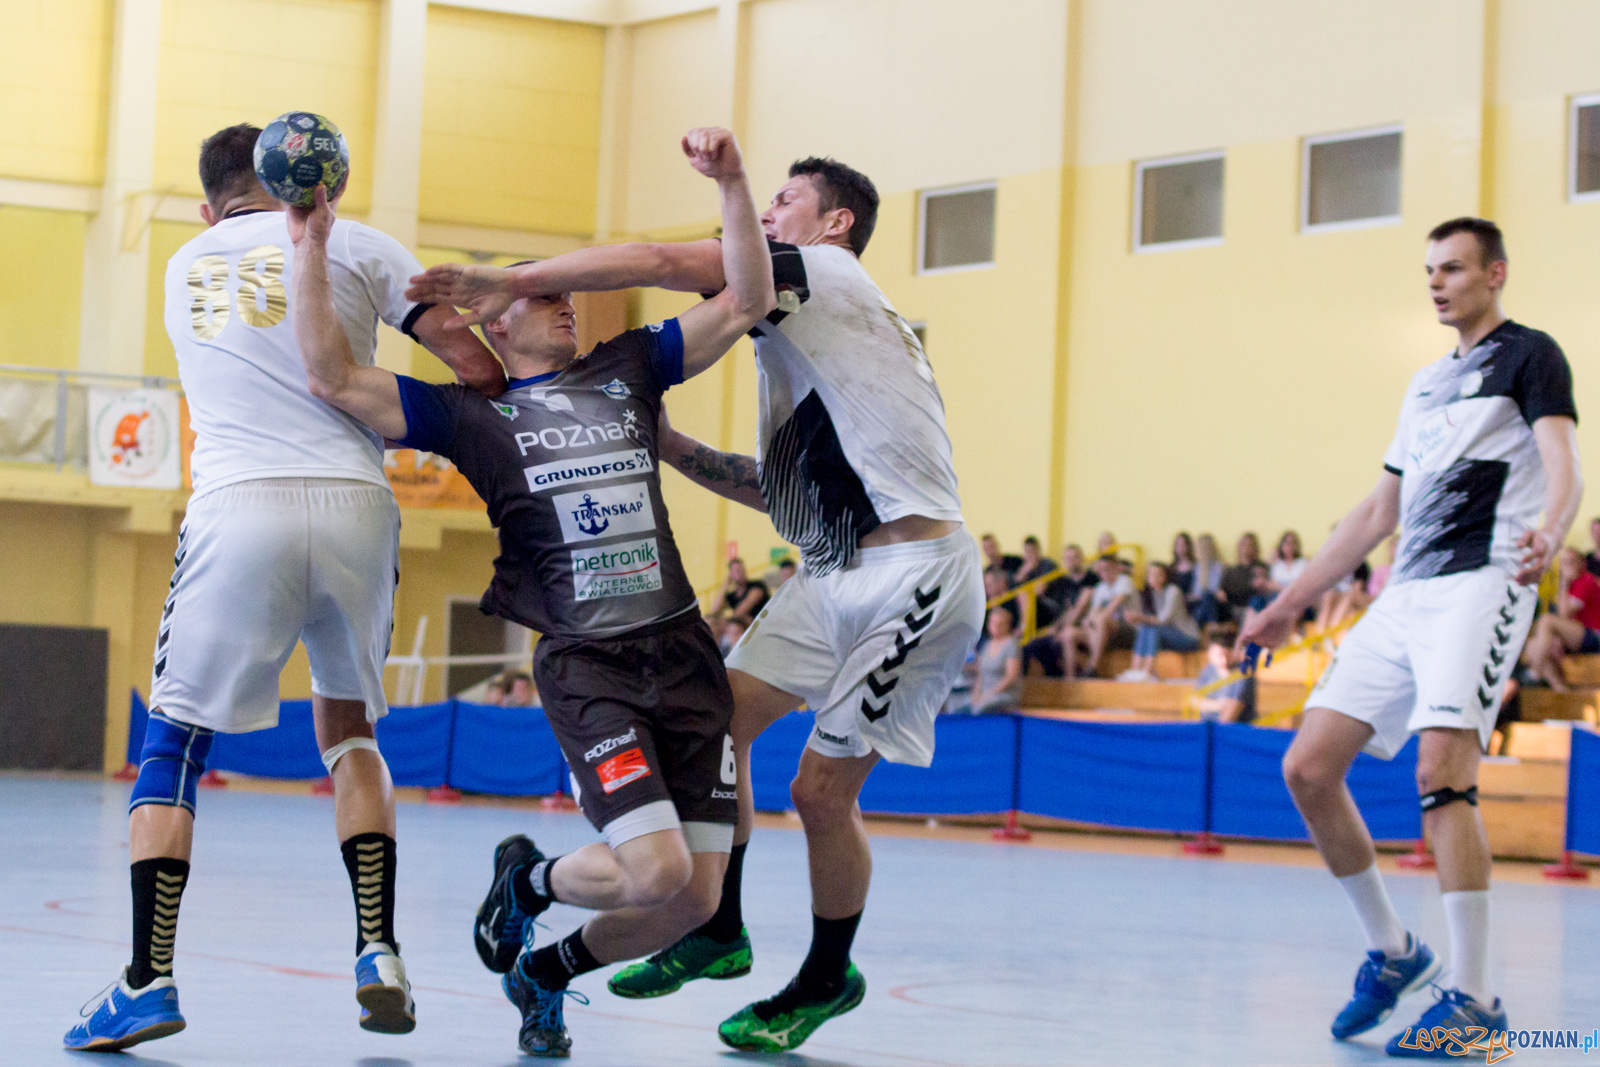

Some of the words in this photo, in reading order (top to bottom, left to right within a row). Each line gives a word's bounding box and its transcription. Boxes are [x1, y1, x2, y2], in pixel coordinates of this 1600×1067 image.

[187, 245, 287, 341] 88
[534, 459, 636, 485] GRUNDFOS
[571, 501, 643, 522] TRANSKAP
[575, 542, 656, 572] netronik
